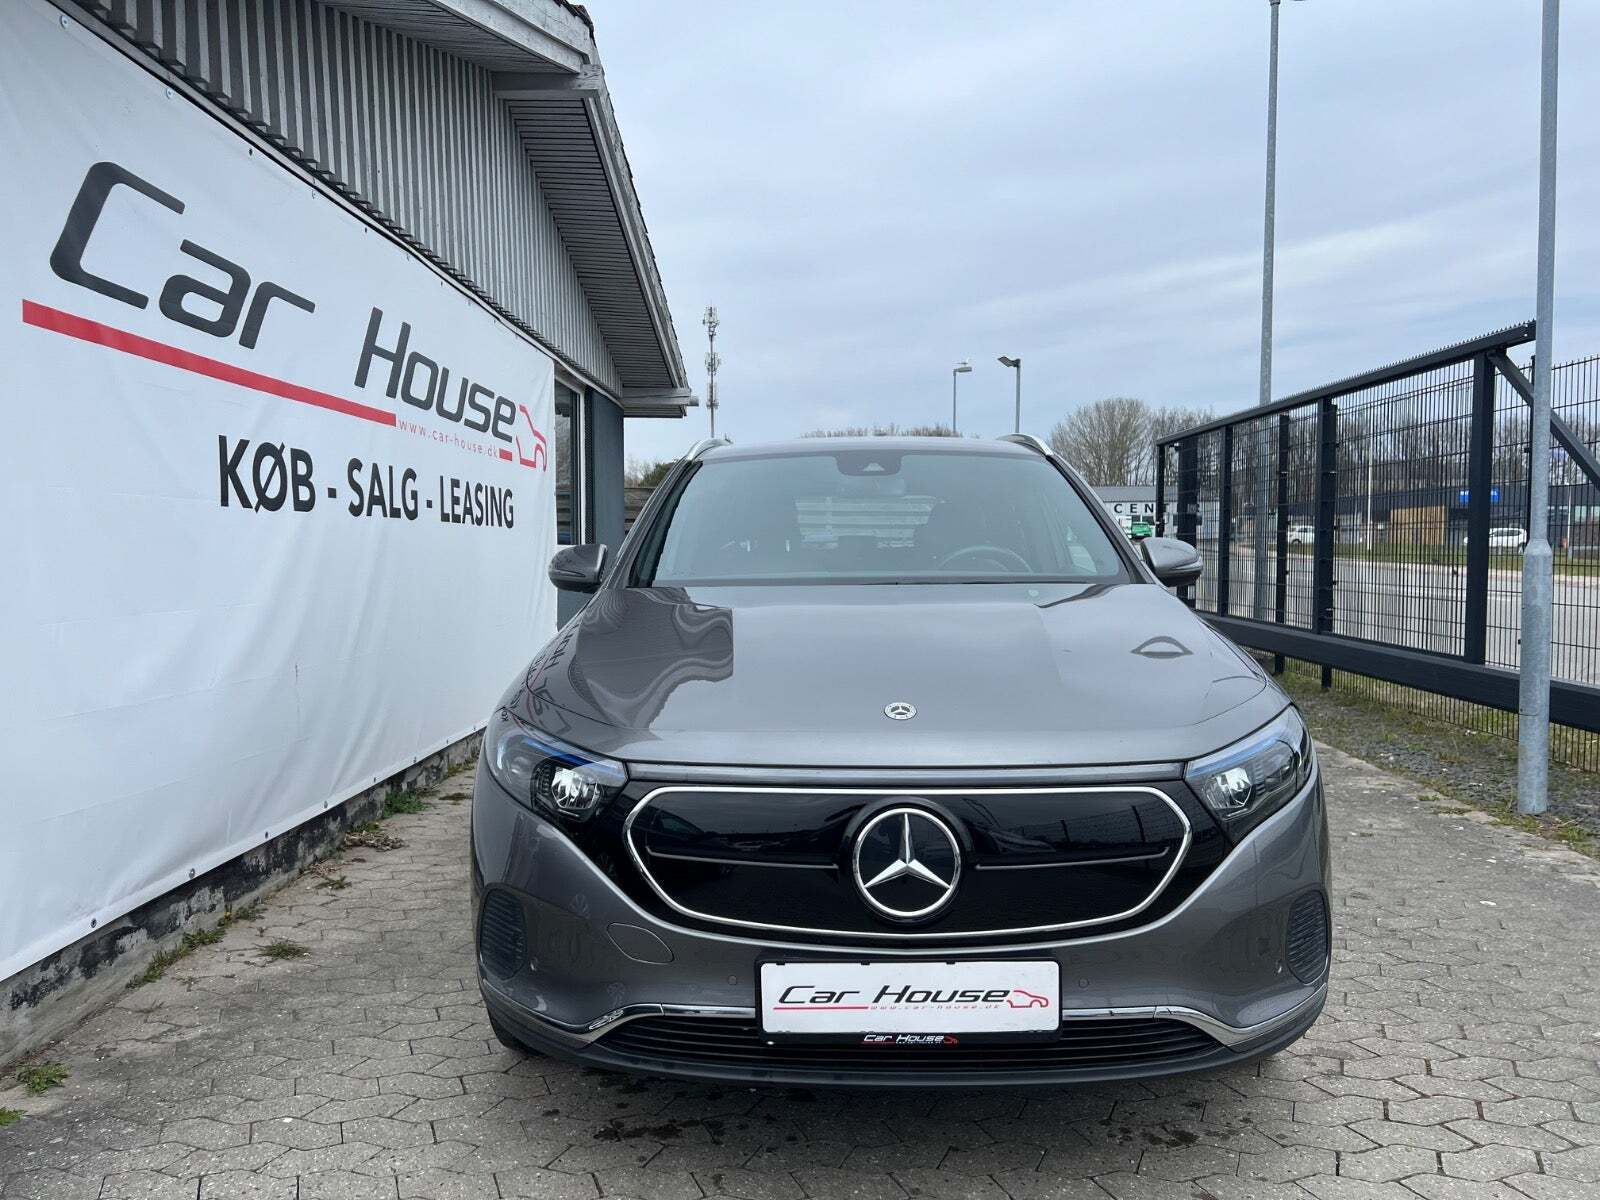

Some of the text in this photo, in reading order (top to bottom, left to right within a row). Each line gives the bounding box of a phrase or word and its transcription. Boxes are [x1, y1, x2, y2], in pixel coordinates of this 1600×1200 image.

[49, 161, 516, 444] Car House
[398, 420, 499, 459] www.car-house.dk
[218, 434, 514, 529] KØB - SALG - LEASING
[778, 984, 1011, 1004] Car House
[863, 1034, 893, 1042] Car
[895, 1033, 945, 1043] House
